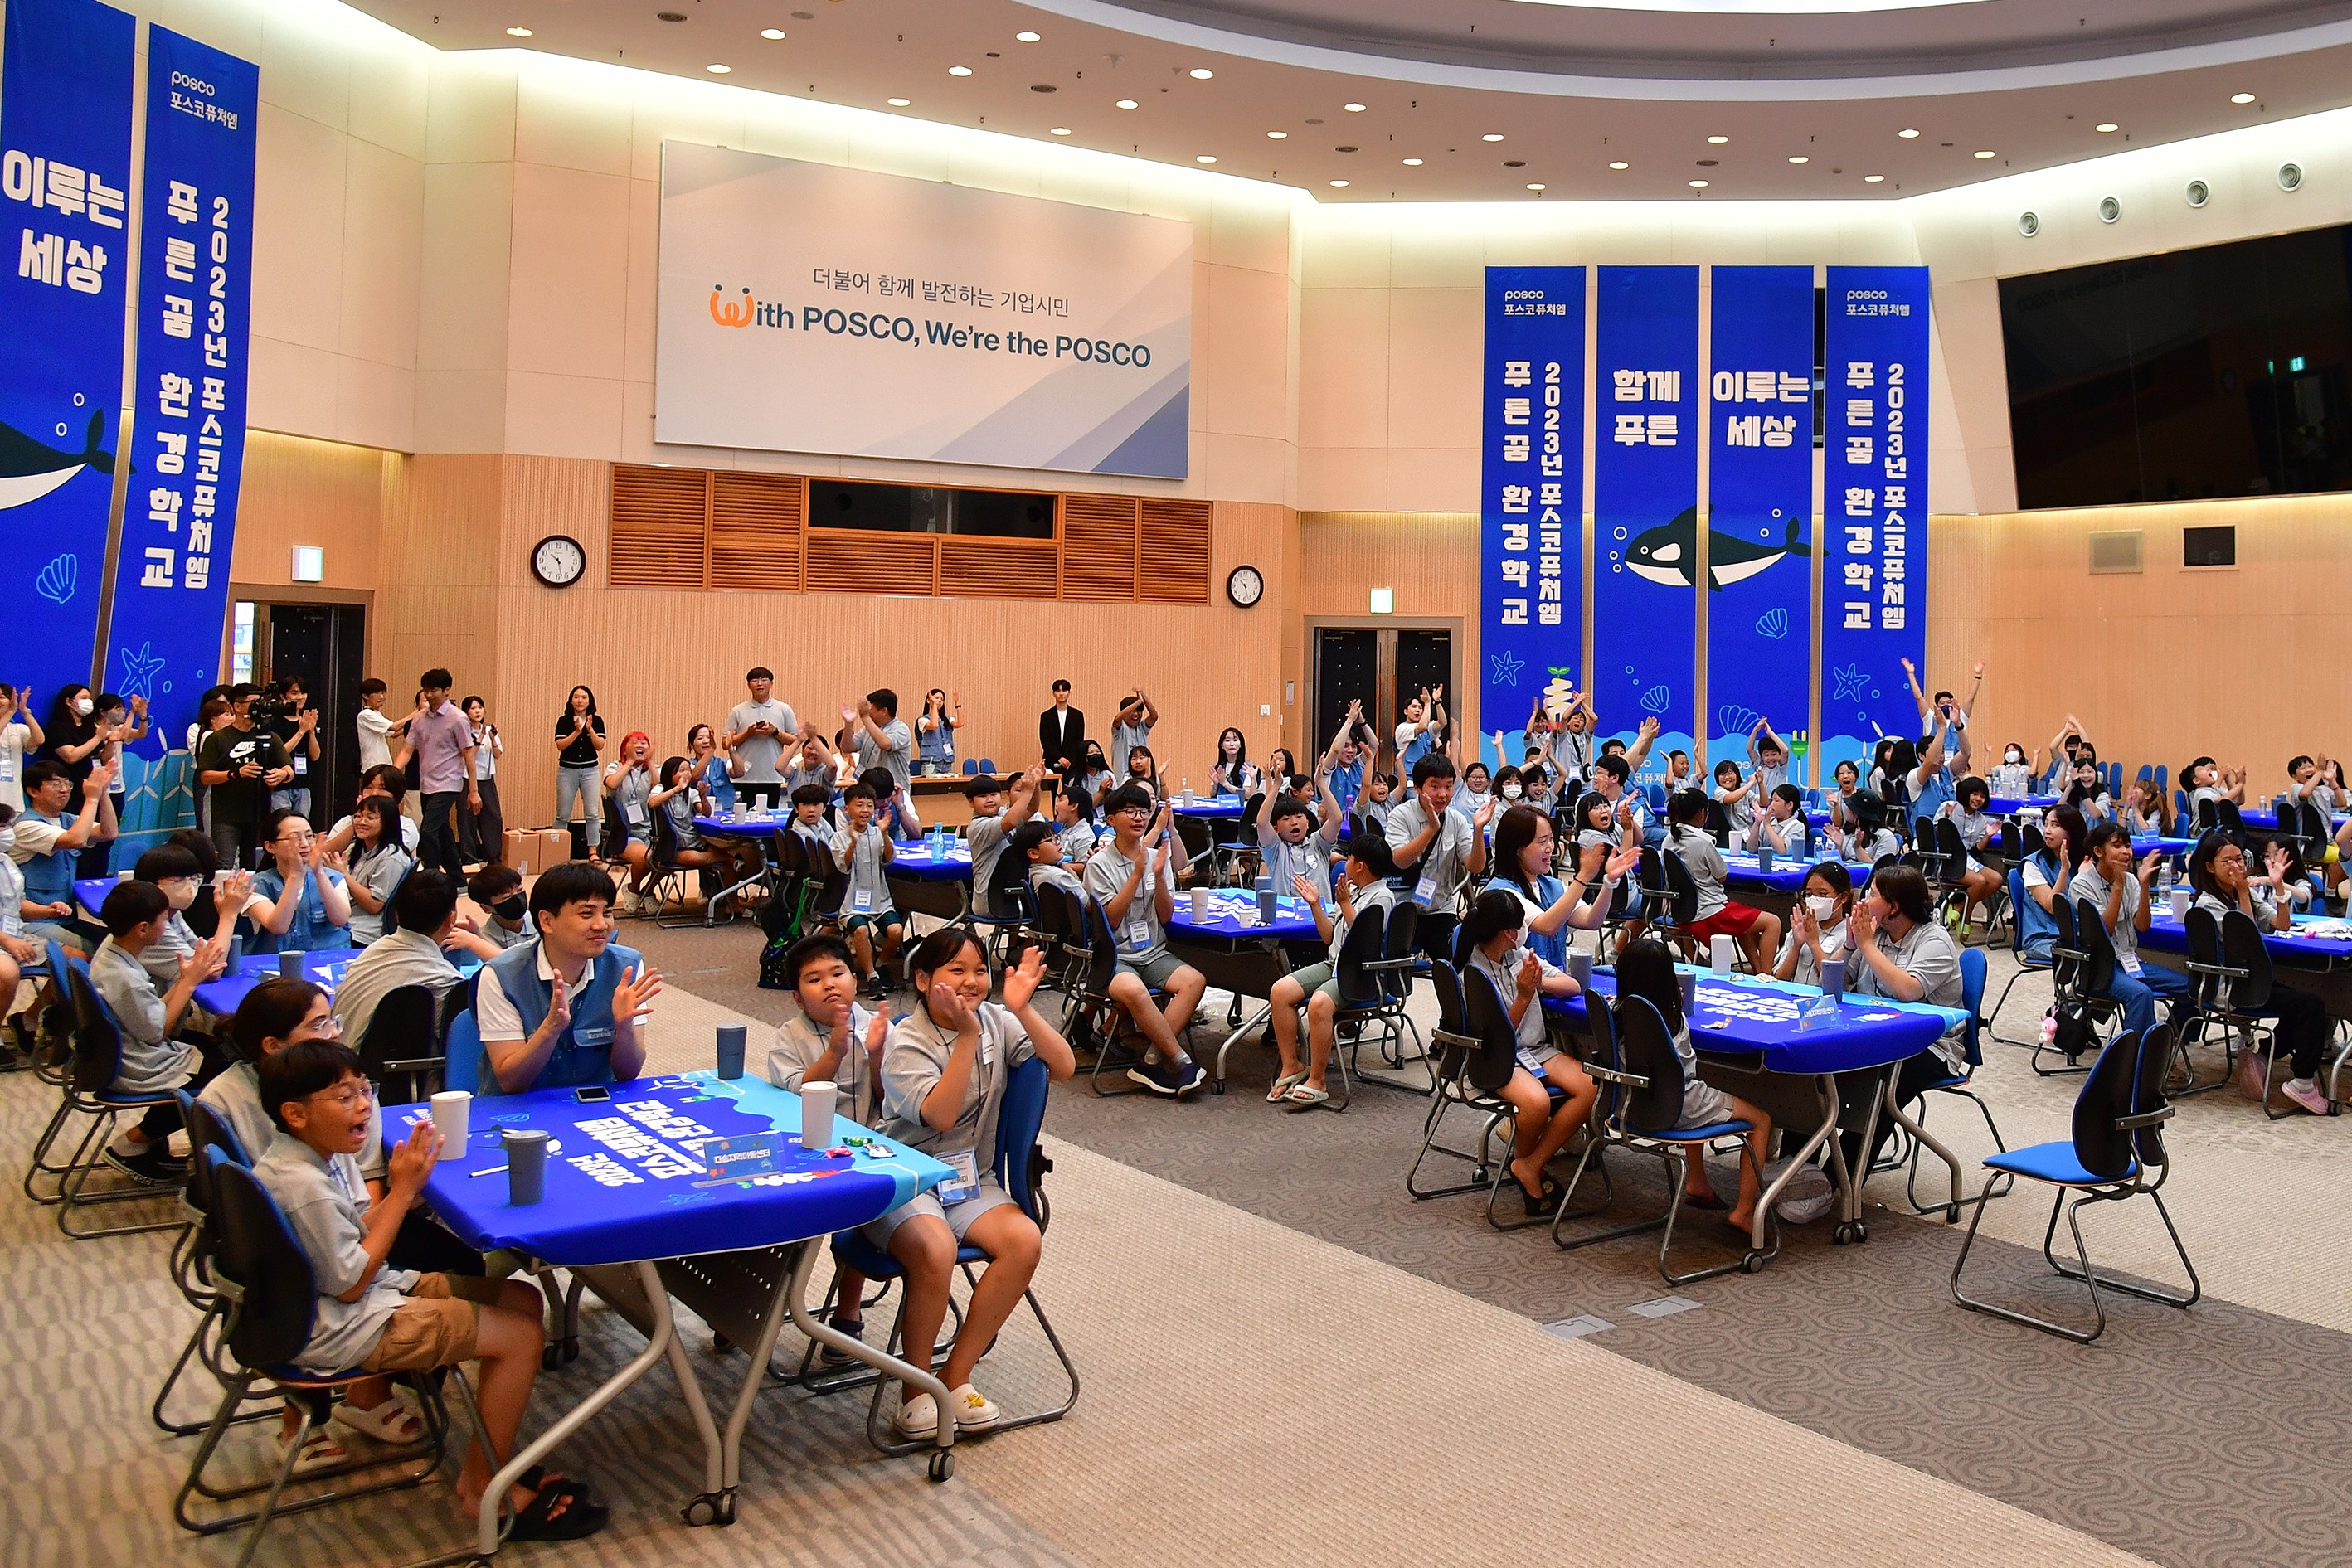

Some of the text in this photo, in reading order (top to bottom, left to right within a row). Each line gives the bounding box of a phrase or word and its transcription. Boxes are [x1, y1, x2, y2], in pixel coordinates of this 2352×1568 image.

[171, 70, 216, 98] posco
[170, 91, 238, 130] 포스코퓨처엠
[2, 149, 125, 230] 이루는
[18, 228, 108, 295] 세상
[813, 268, 1069, 318] 더불어 함께 발전하는 기업시민
[1504, 290, 1544, 302] posco
[1504, 303, 1567, 316] 포스코퓨처엠
[1846, 304, 1910, 317] 포스코퓨처엠
[1847, 290, 1888, 302] posco
[710, 284, 794, 329] With
[803, 306, 920, 347] POSCO,
[1006, 331, 1049, 357] the
[1055, 335, 1151, 368] POSCO
[140, 179, 198, 589] 푸른꿈 환경학교
[185, 196, 230, 589] 2023년 포스코퓨처엠
[1613, 369, 1680, 402] 함께
[1713, 371, 1810, 403] 이루는
[1614, 415, 1679, 446] 푸른
[1727, 415, 1796, 447] 세상
[1501, 361, 1532, 624] 푸른꿈 환경학교
[1538, 362, 1562, 624] 2023년 포스코퓨처엠
[1844, 362, 1875, 629] 푸른꿈 환경학교
[1881, 362, 1907, 629] 2023년 포스코퓨처엠
[1635, 772, 1666, 784] 코퓨처
